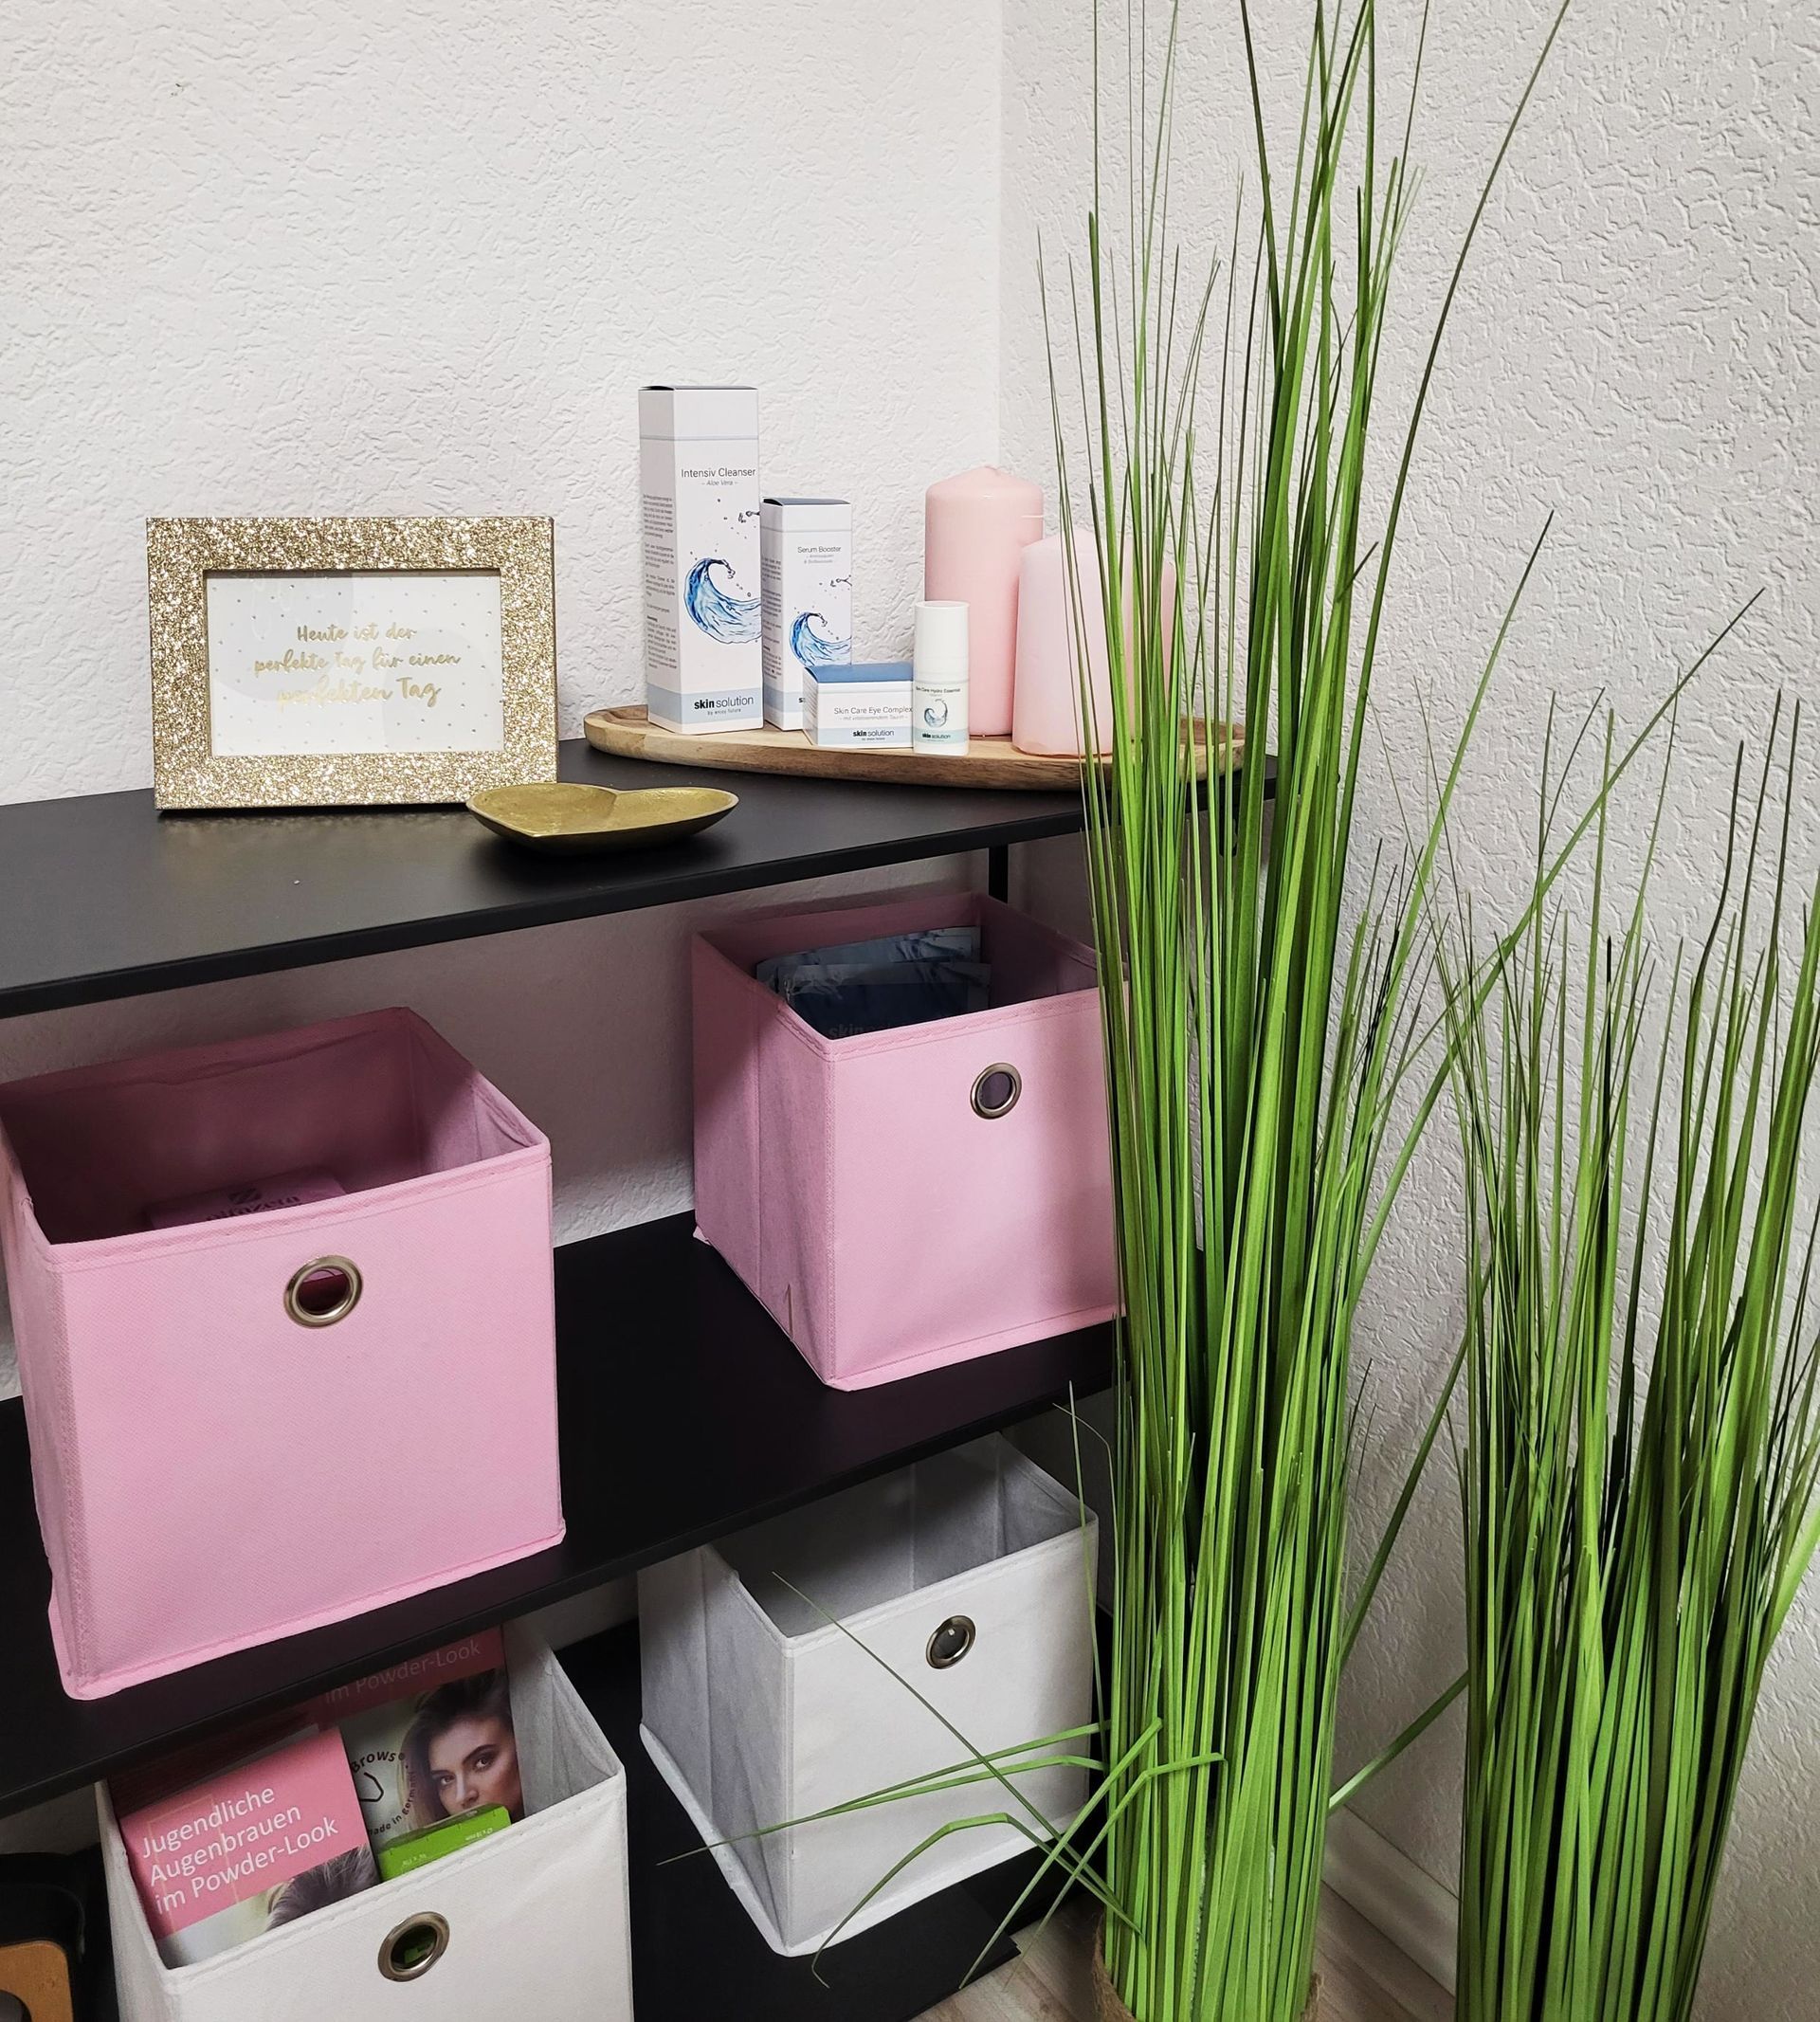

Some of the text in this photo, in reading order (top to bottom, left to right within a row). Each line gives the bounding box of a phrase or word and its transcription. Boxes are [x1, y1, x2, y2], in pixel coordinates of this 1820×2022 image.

[681, 467, 756, 478] Intensiv Cleanser
[297, 622, 417, 642] Heute ist der
[254, 647, 461, 677] perfekte Tag für einen
[276, 674, 443, 712] perfekten Tag
[694, 696, 755, 710] skin solution
[868, 706, 882, 716] Eye
[883, 705, 913, 715] Complex
[355, 1640, 482, 1694] Powder-Look
[143, 1788, 275, 1858] Jugendliche
[391, 1814, 403, 1825] in
[150, 1806, 301, 1886] Augenbrauen
[155, 1816, 339, 1915] im Powder-Look
